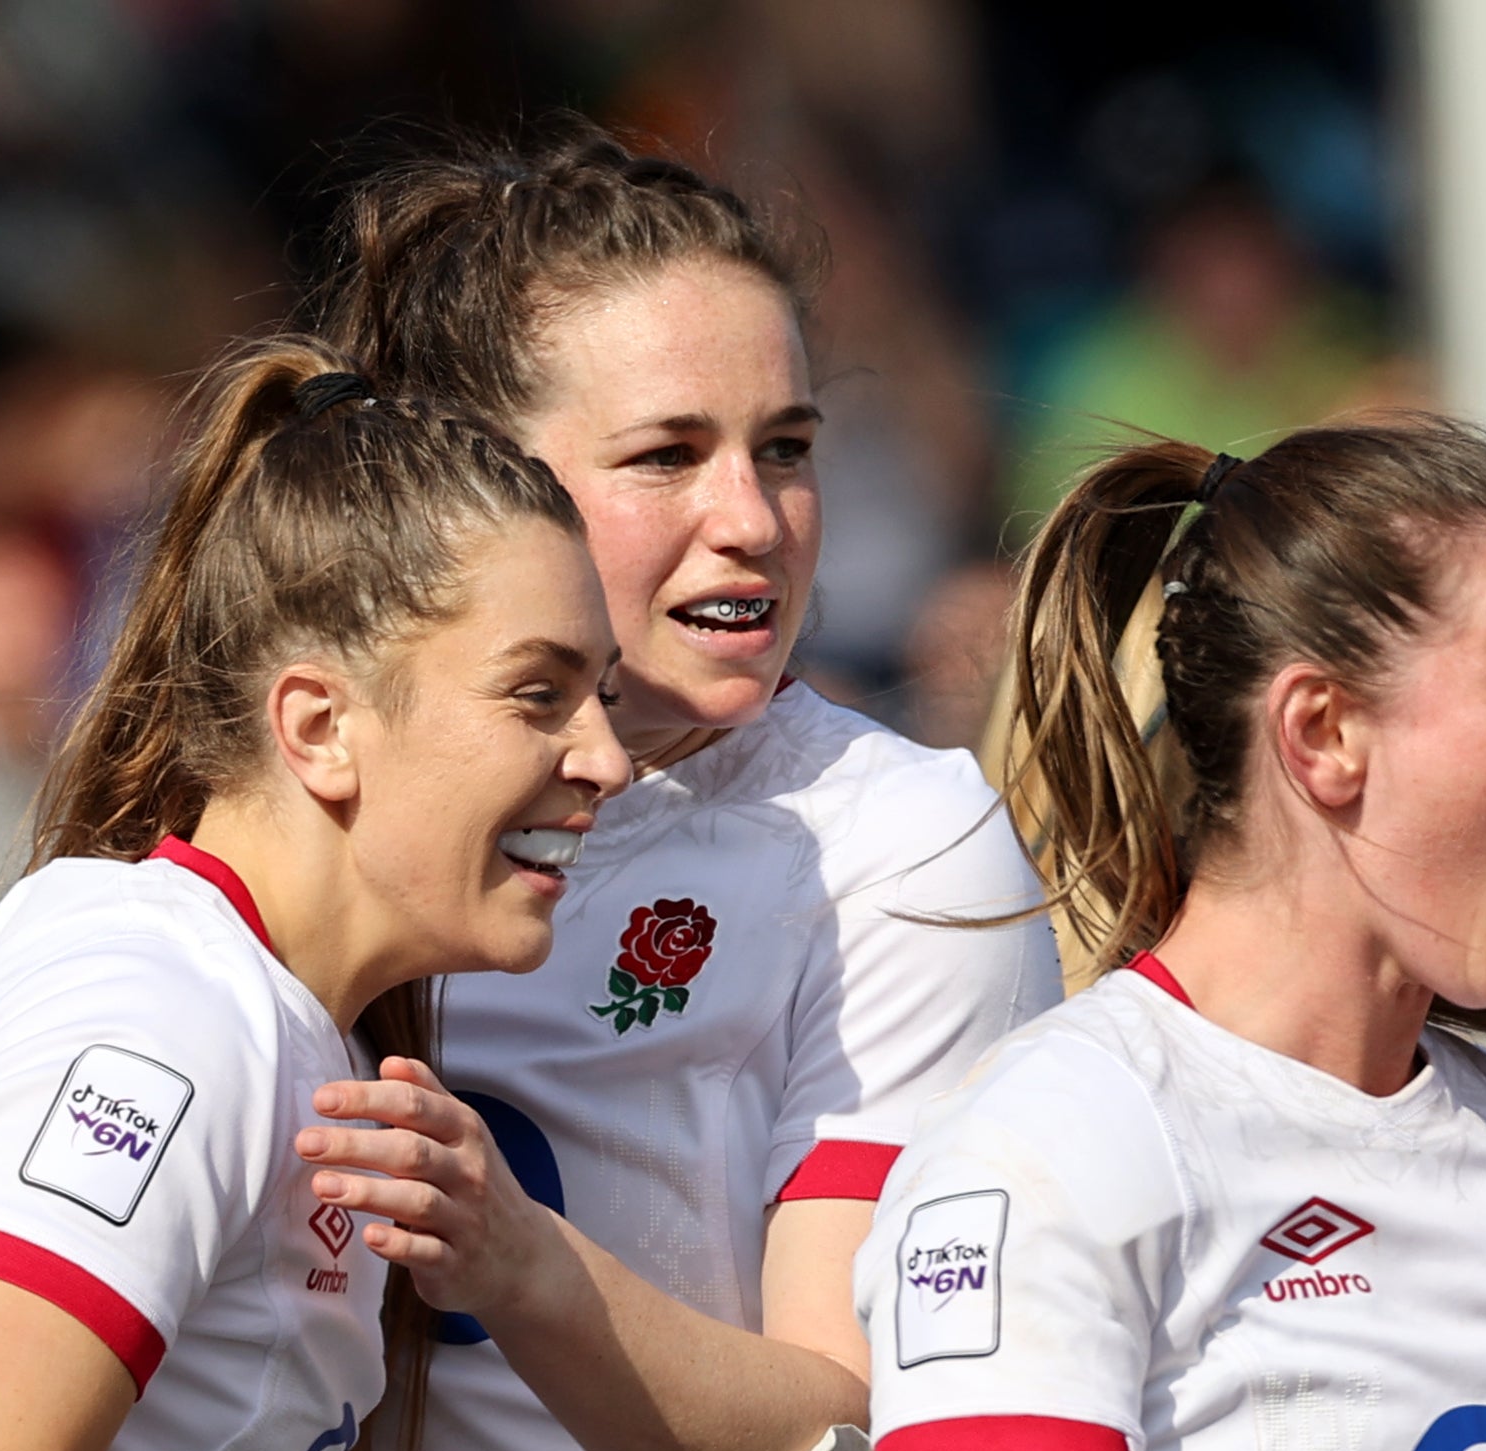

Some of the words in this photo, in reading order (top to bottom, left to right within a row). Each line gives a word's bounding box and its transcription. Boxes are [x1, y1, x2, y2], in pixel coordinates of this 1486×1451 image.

[717, 597, 764, 619] opro
[97, 1093, 161, 1139] TikTok
[925, 1243, 989, 1266] TikTok
[1262, 1269, 1372, 1303] umbro
